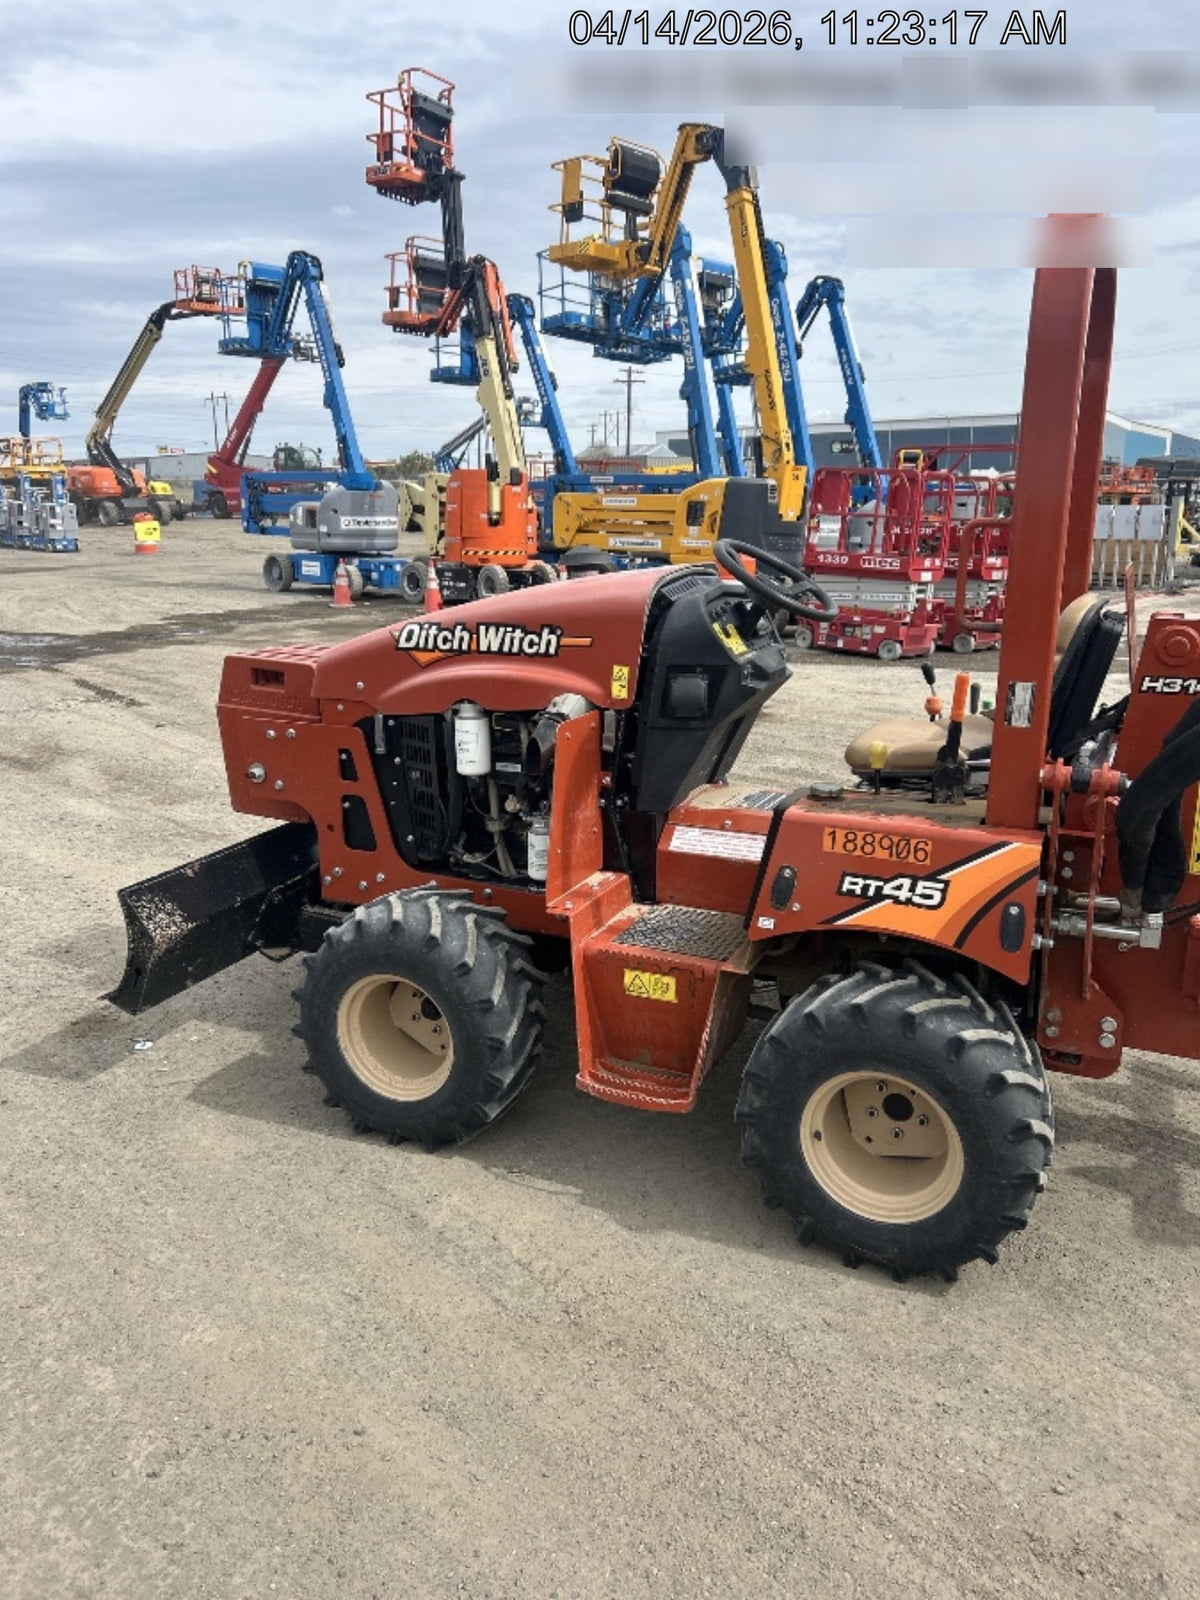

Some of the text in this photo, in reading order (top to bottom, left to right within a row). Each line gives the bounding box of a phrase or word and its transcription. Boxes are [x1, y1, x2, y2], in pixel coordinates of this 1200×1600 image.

[397, 623, 560, 656] Ditch Witch
[826, 828, 930, 863] 188906
[840, 875, 947, 907] RT45
